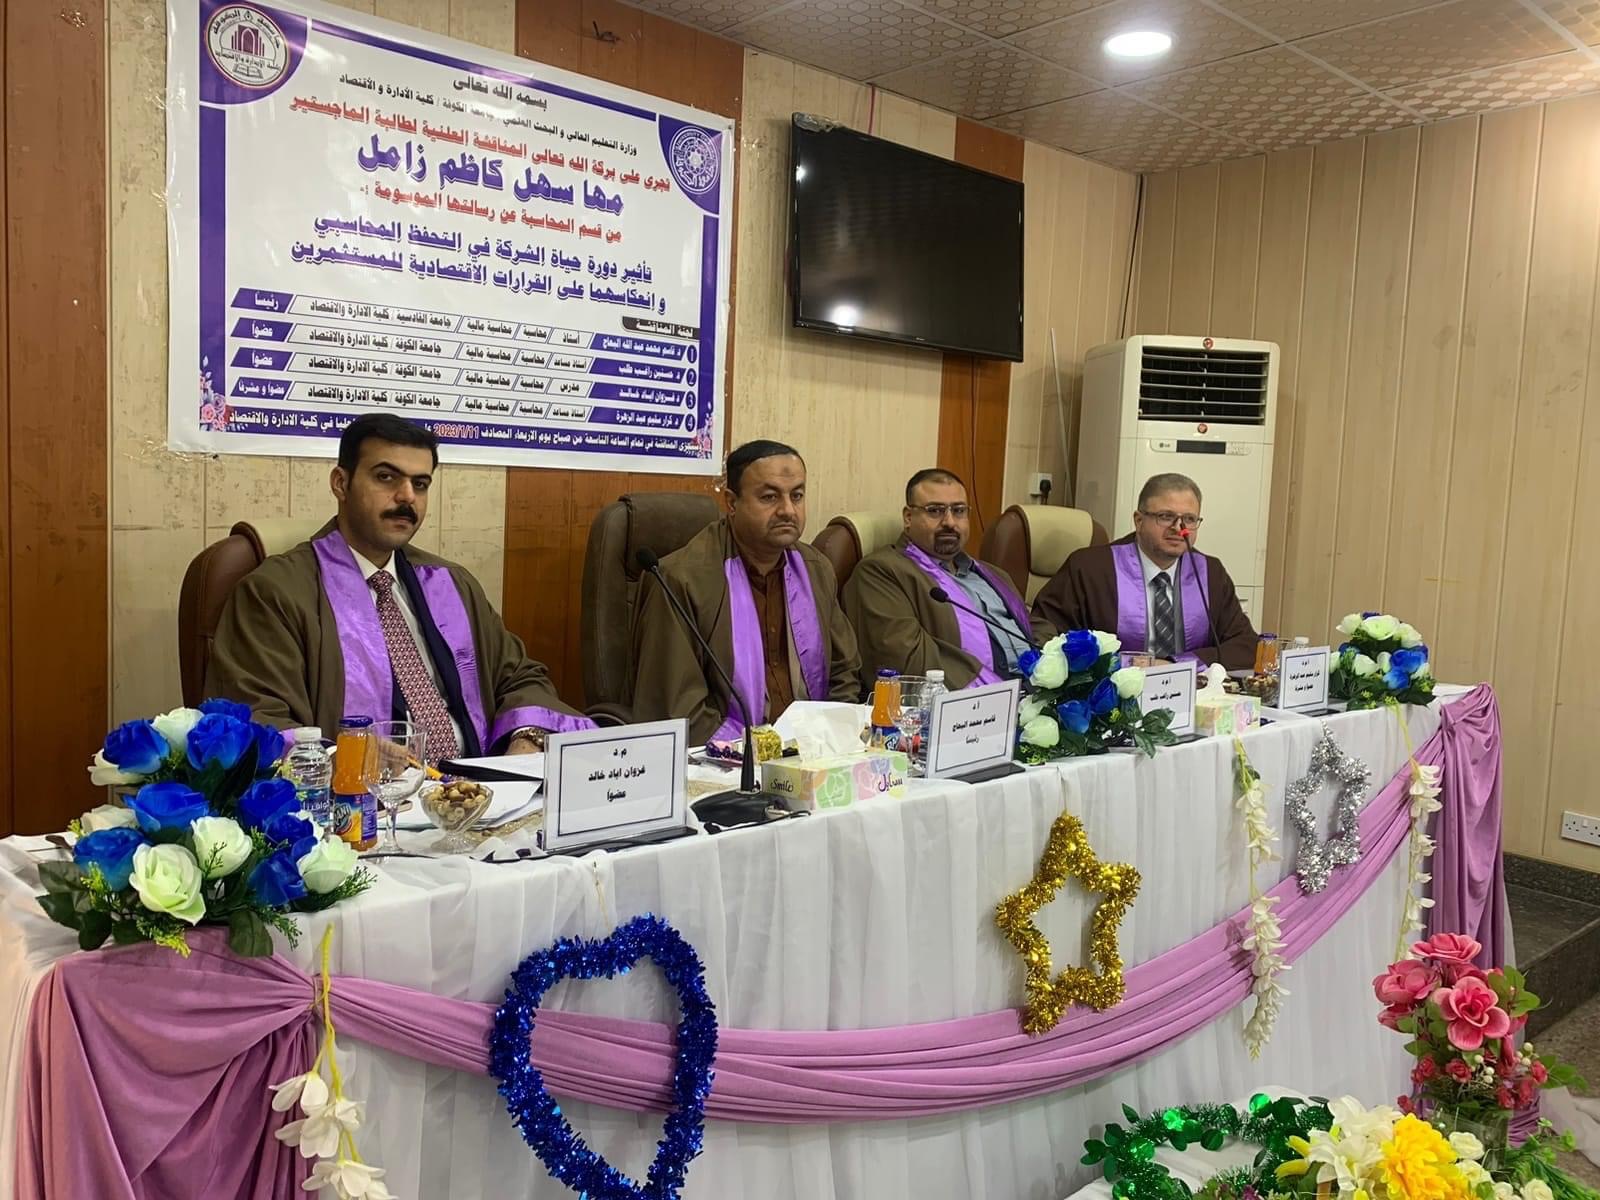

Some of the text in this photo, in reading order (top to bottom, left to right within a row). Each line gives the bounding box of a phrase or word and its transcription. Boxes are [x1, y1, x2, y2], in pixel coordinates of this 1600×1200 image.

[378, 84, 384, 95] و
[453, 75, 489, 93] تعالى
[416, 91, 434, 106] كلية
[493, 84, 512, 100] الله
[288, 94, 370, 124] الماجستير
[443, 97, 467, 113] الكوفة
[375, 109, 417, 135] لطالبة
[533, 120, 558, 136] البحث
[422, 120, 469, 146] العلنية
[560, 129, 564, 139] و
[567, 131, 590, 144] العالي
[473, 131, 527, 158] المناقشة
[592, 136, 618, 150] التعليم
[619, 143, 637, 156] وزارة
[532, 147, 565, 167] تعالى
[569, 156, 588, 173] الله
[592, 159, 616, 180] بركة
[357, 132, 624, 216] مها سهل كاظم زامل
[619, 169, 640, 185] على
[374, 181, 442, 209] الموسومة
[447, 194, 495, 222] رسالتها
[500, 208, 516, 224] عن
[521, 208, 575, 234] المحاسبة
[579, 224, 602, 240] قسم
[606, 230, 622, 243] من
[313, 214, 652, 284] تأثير دورة حياة الشركة في التحفظ المحاسبي
[290, 241, 403, 273] للمستثمرين
[492, 269, 552, 296] القرارات
[557, 279, 584, 300] على
[658, 297, 666, 315] و
[373, 308, 389, 321] كلية
[397, 312, 427, 325] القادسية
[429, 315, 451, 328] جامعة
[467, 319, 485, 332] مالية
[487, 322, 512, 335] محاسبة
[523, 326, 547, 338] محاسبة
[372, 336, 389, 350] كلية
[395, 338, 417, 353] الكوفة
[419, 340, 442, 353] جامعة
[466, 345, 484, 359] مالية
[486, 348, 511, 361] محاسبة
[521, 352, 545, 365] محاسبة
[372, 362, 388, 376] كلية
[395, 364, 417, 378] الكوفة
[419, 366, 441, 380] جامعة
[465, 371, 483, 385] مالية
[486, 374, 511, 387] محاسبة
[520, 378, 544, 390] محاسبة
[371, 391, 388, 404] كلية
[394, 392, 416, 406] الكوفة
[418, 395, 441, 409] جامعة
[465, 397, 482, 411] مالية
[485, 400, 510, 413] محاسبة
[519, 402, 543, 415] محاسبة
[300, 414, 318, 430] كلية
[320, 417, 333, 432] في
[433, 423, 479, 439] 2023/1/11
[481, 427, 512, 439] المصادف
[553, 432, 571, 444] صباح
[538, 433, 551, 444] يوم
[573, 434, 583, 445] من
[585, 433, 609, 445] التاسعة
[610, 436, 629, 447] الساعة
[771, 778, 794, 793] Smile
